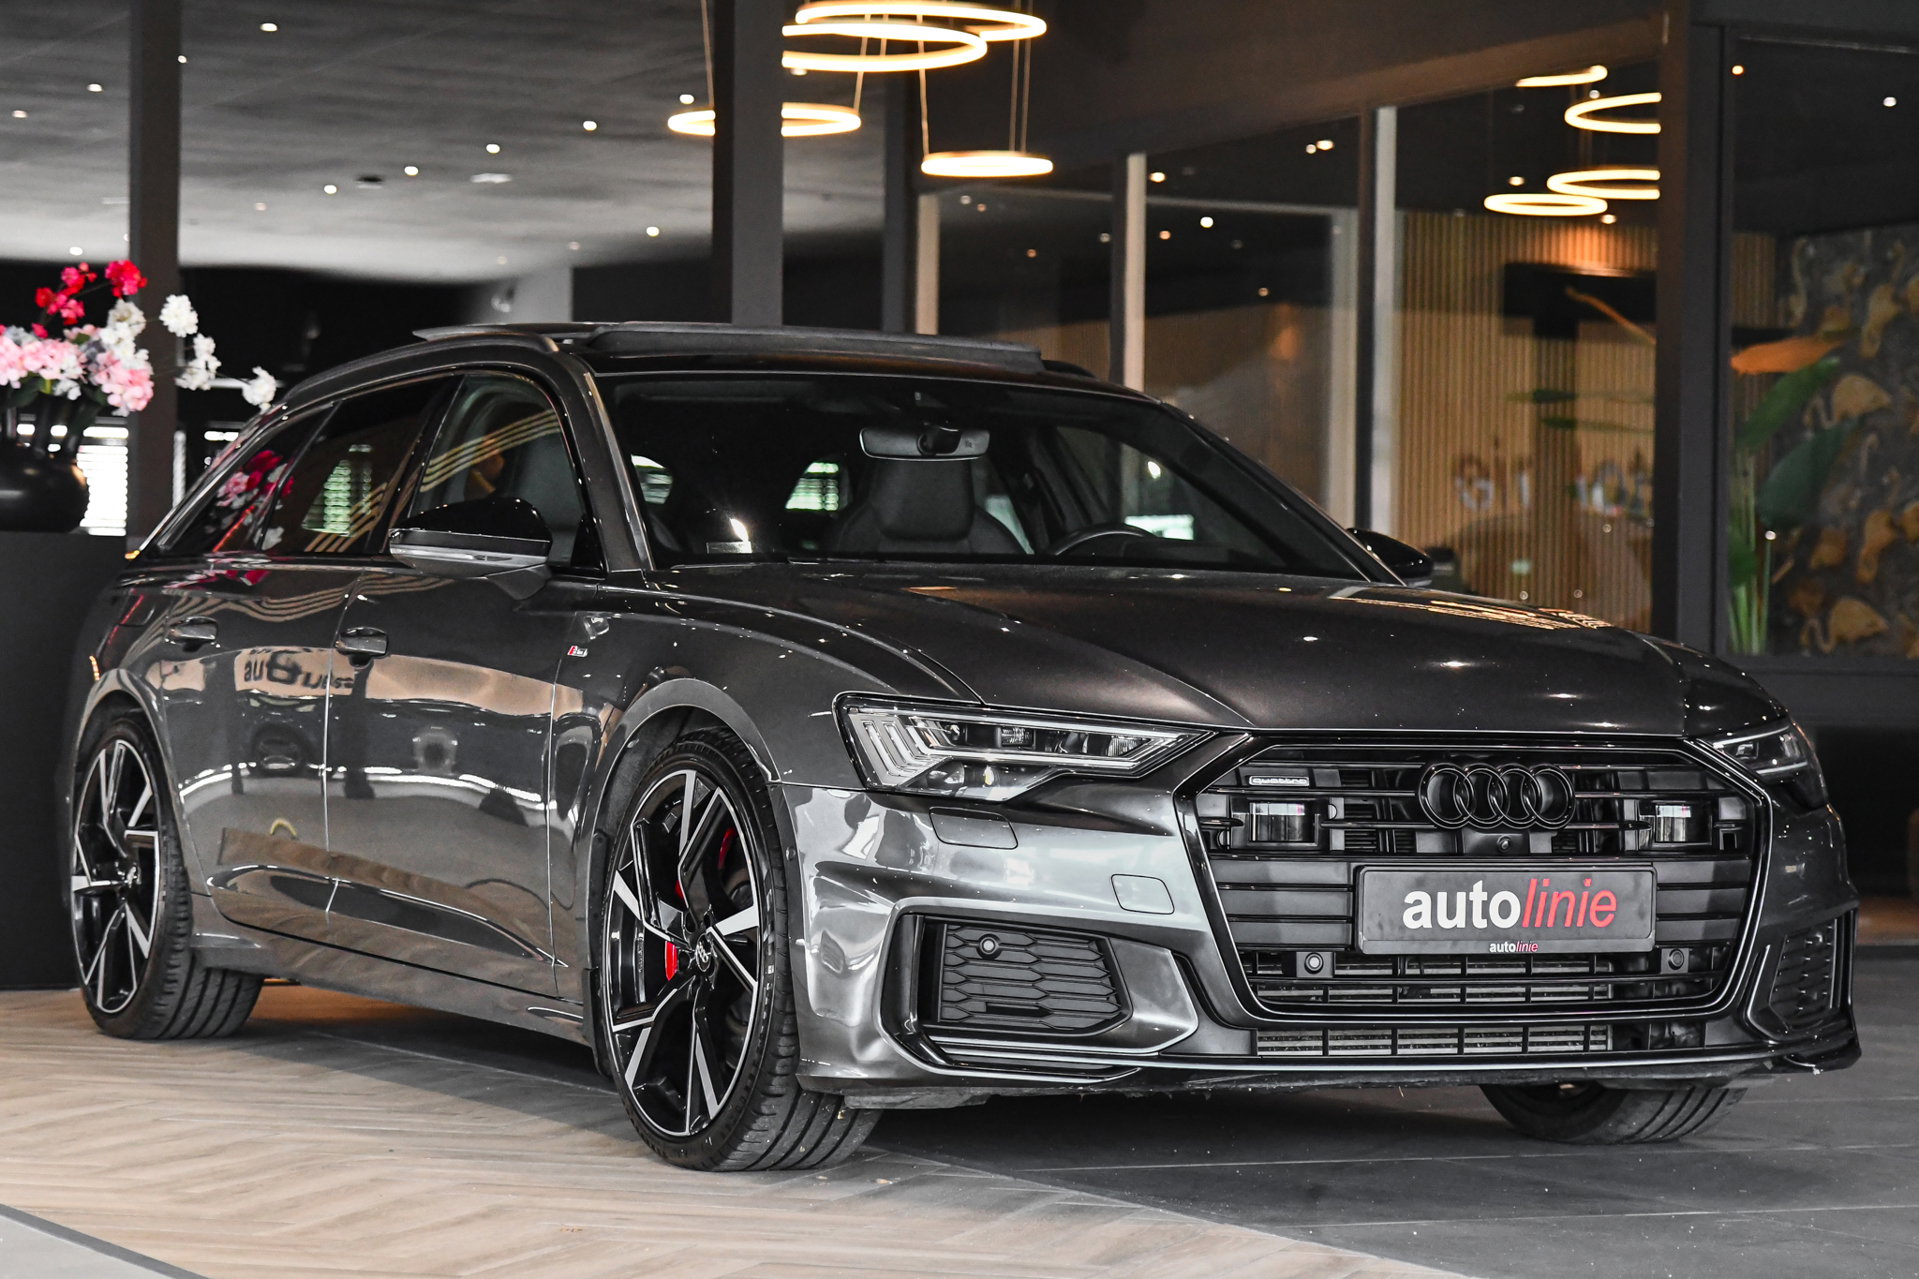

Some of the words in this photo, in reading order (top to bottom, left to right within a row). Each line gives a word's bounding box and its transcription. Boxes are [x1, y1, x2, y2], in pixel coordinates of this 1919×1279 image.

[1251, 777, 1308, 785] quattro
[1402, 878, 1617, 929] autolinie
[1489, 941, 1539, 953] autolinie
